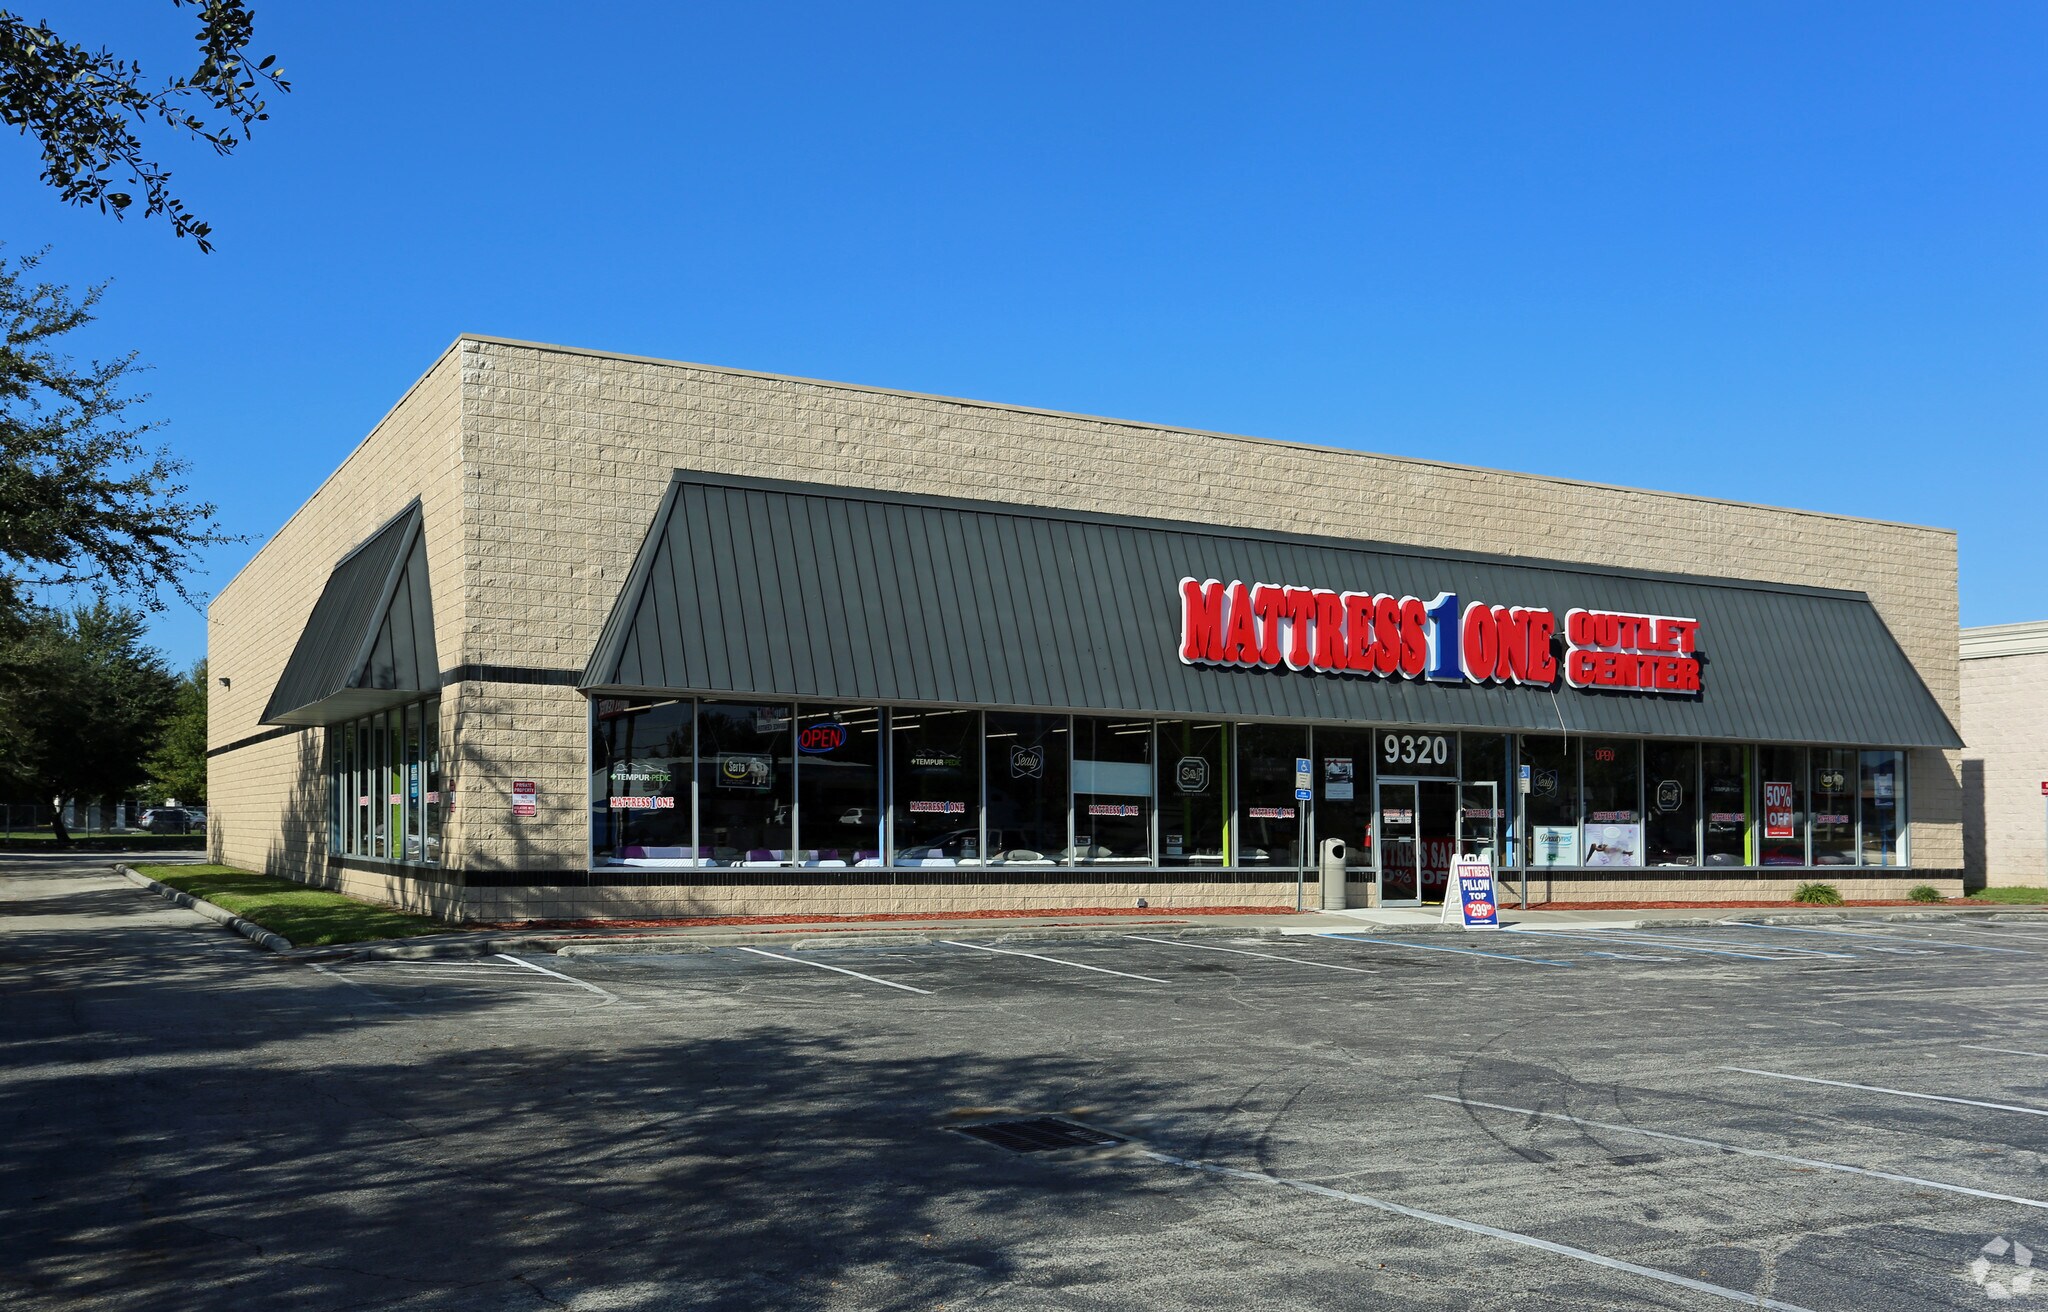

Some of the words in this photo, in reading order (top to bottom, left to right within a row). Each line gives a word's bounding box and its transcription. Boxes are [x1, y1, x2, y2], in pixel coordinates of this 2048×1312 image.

[1182, 579, 1427, 676] MATTRESS
[1464, 603, 1556, 684] ONE
[1570, 611, 1699, 652] OUTLET
[1569, 650, 1700, 690] CENTER
[801, 729, 841, 747] OPEN
[1384, 735, 1447, 764] 9320
[1595, 750, 1615, 761] OPEN
[729, 761, 746, 773] Serta
[1014, 753, 1039, 769] Sealy
[1766, 785, 1791, 807] 50%
[1769, 812, 1790, 825] OFF
[1430, 841, 1454, 869] SAL
[1421, 869, 1449, 885] OF
[1458, 866, 1490, 877] MATTRESS
[1462, 879, 1490, 890] PILLOW
